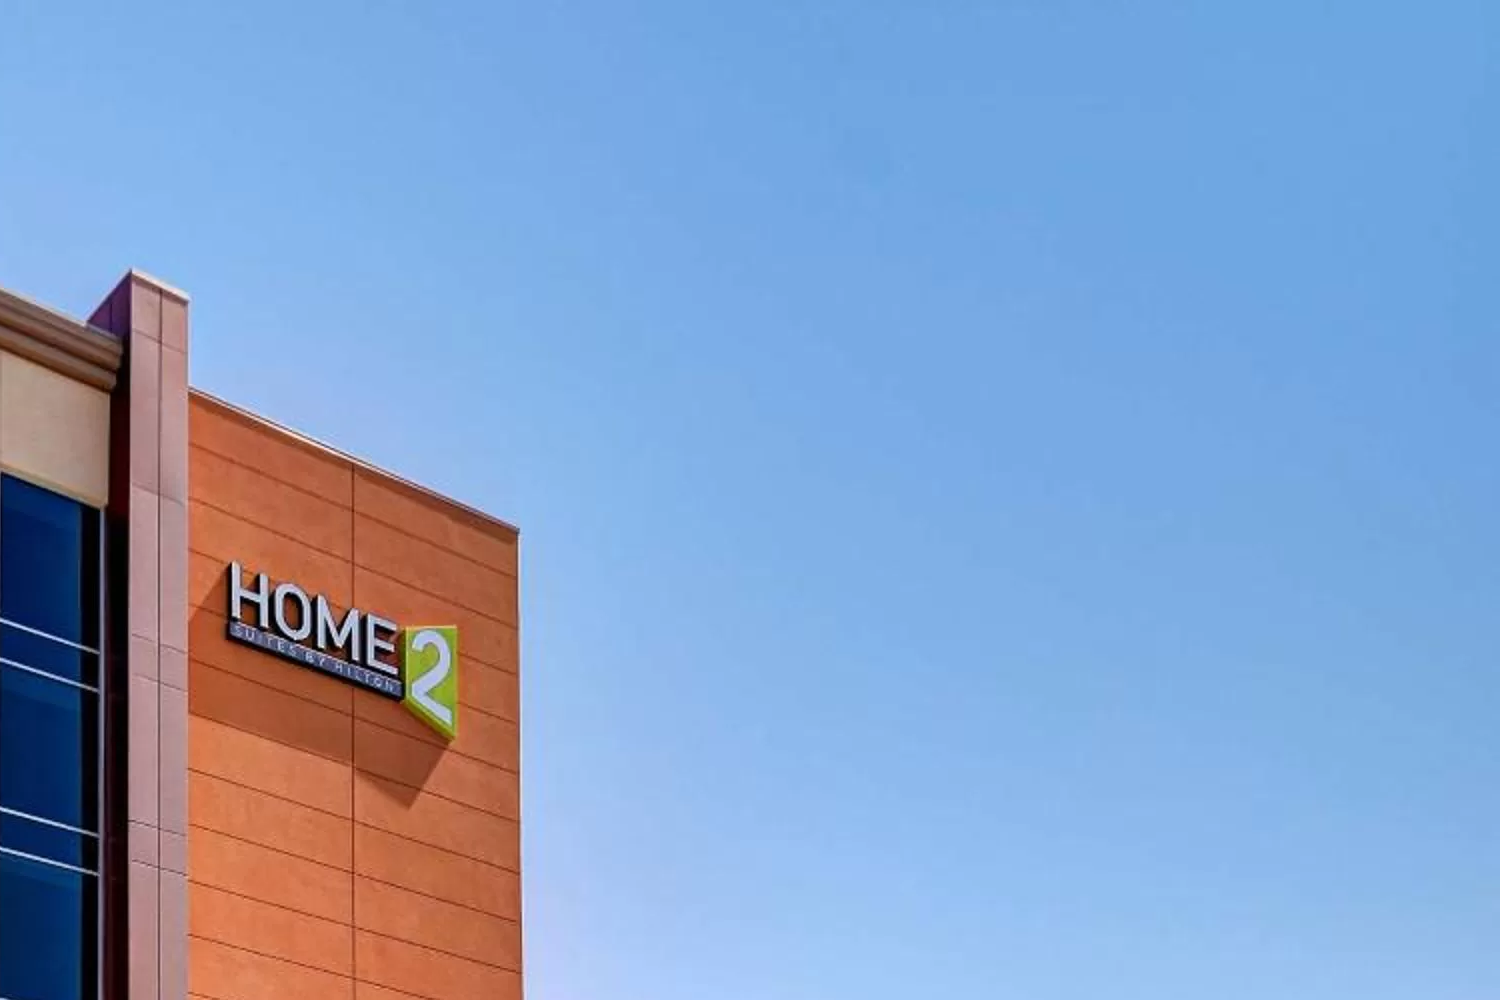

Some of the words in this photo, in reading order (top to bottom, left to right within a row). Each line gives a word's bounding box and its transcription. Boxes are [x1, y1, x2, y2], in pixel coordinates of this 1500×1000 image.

[229, 560, 399, 675] HOME
[411, 629, 453, 727] 2
[234, 625, 298, 657] SUITES
[305, 651, 326, 667] BY
[335, 662, 395, 692] HILTON
